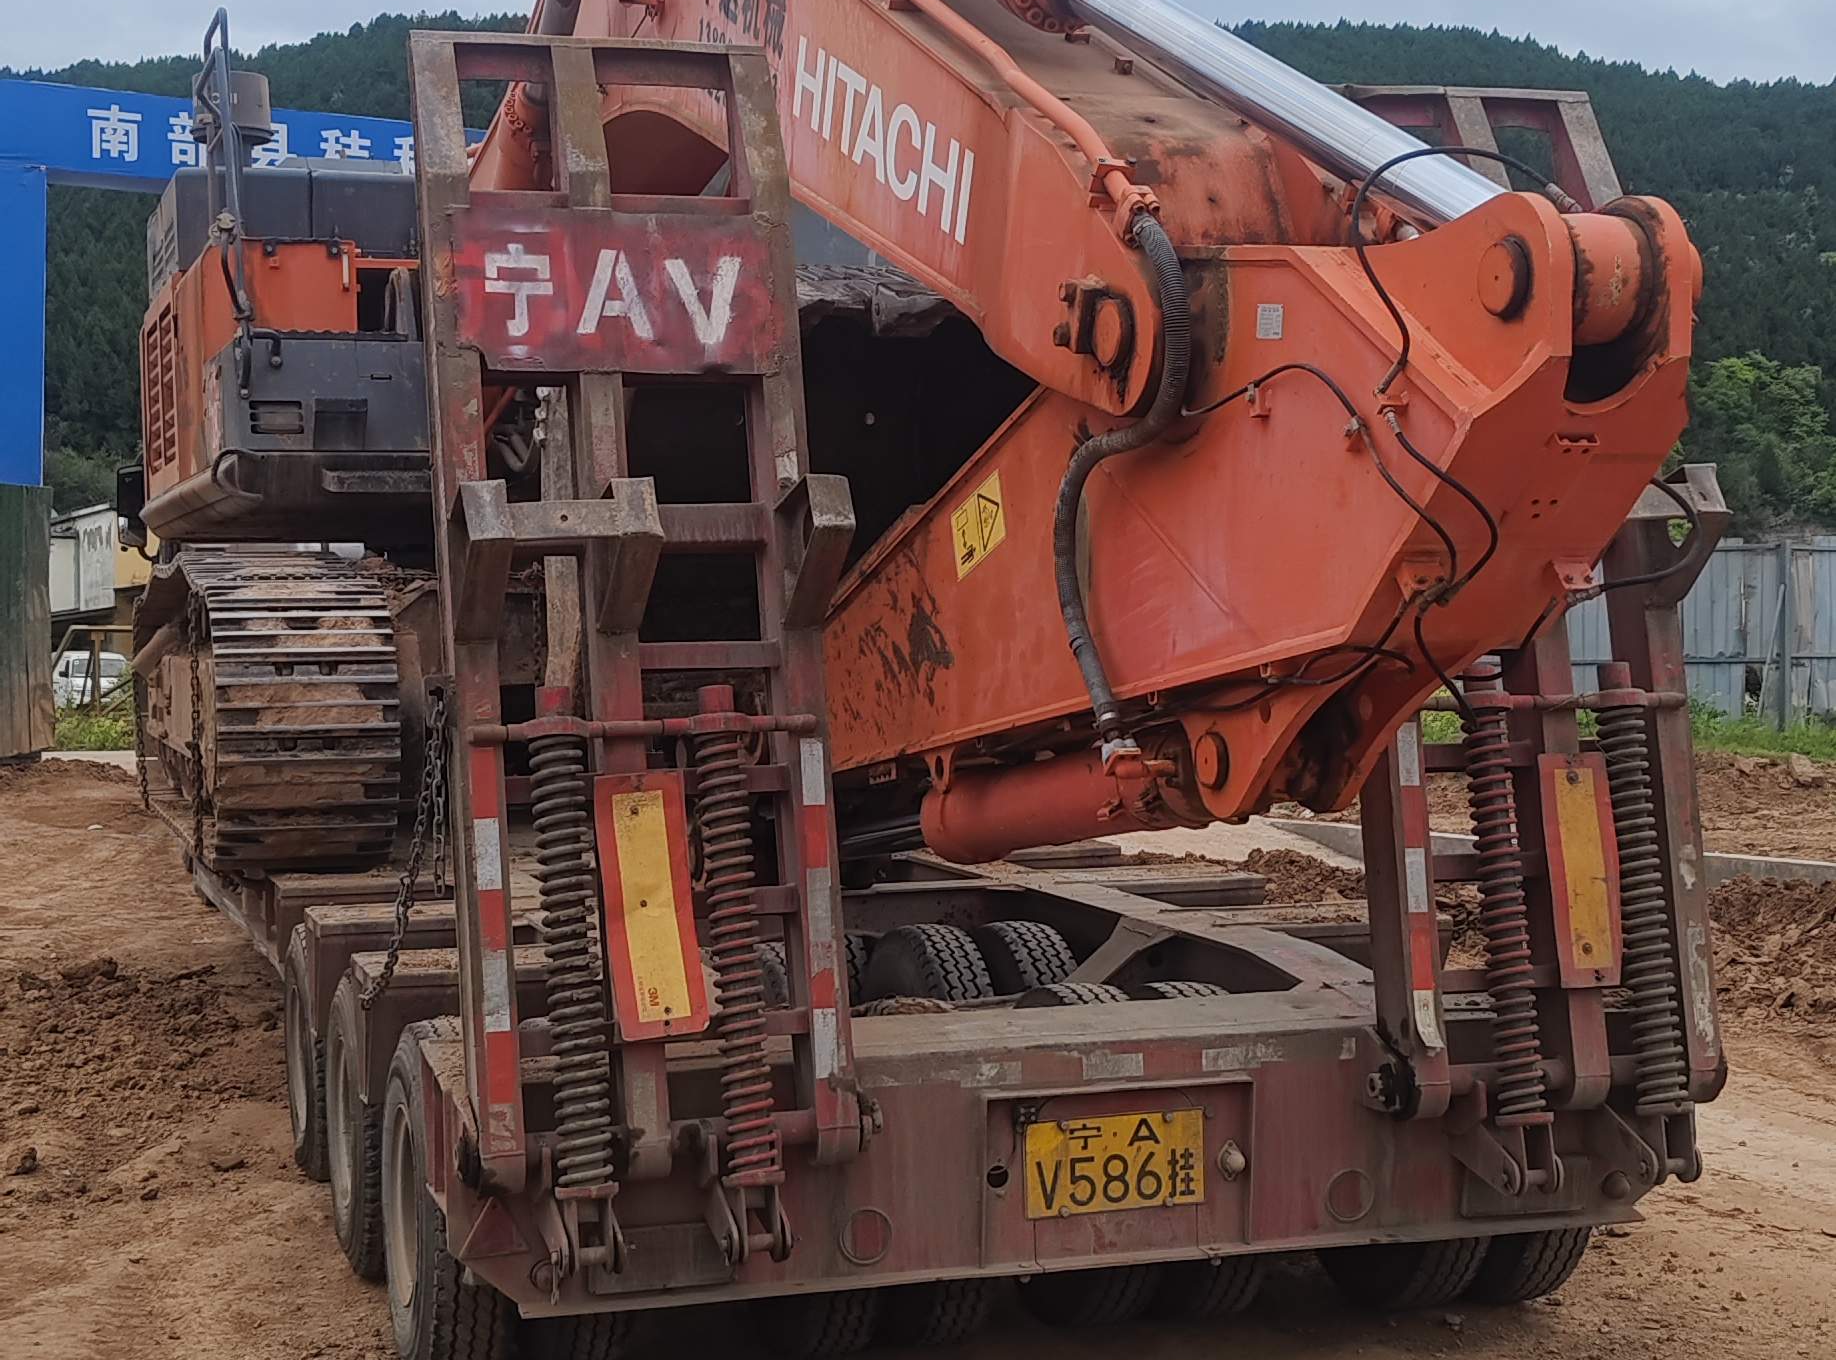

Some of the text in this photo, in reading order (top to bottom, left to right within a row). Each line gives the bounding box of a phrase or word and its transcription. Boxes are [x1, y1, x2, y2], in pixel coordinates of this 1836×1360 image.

[793, 36, 975, 245] HITACHI
[648, 987, 660, 1007] 3M
[1036, 1148, 1196, 1210] V586挂
